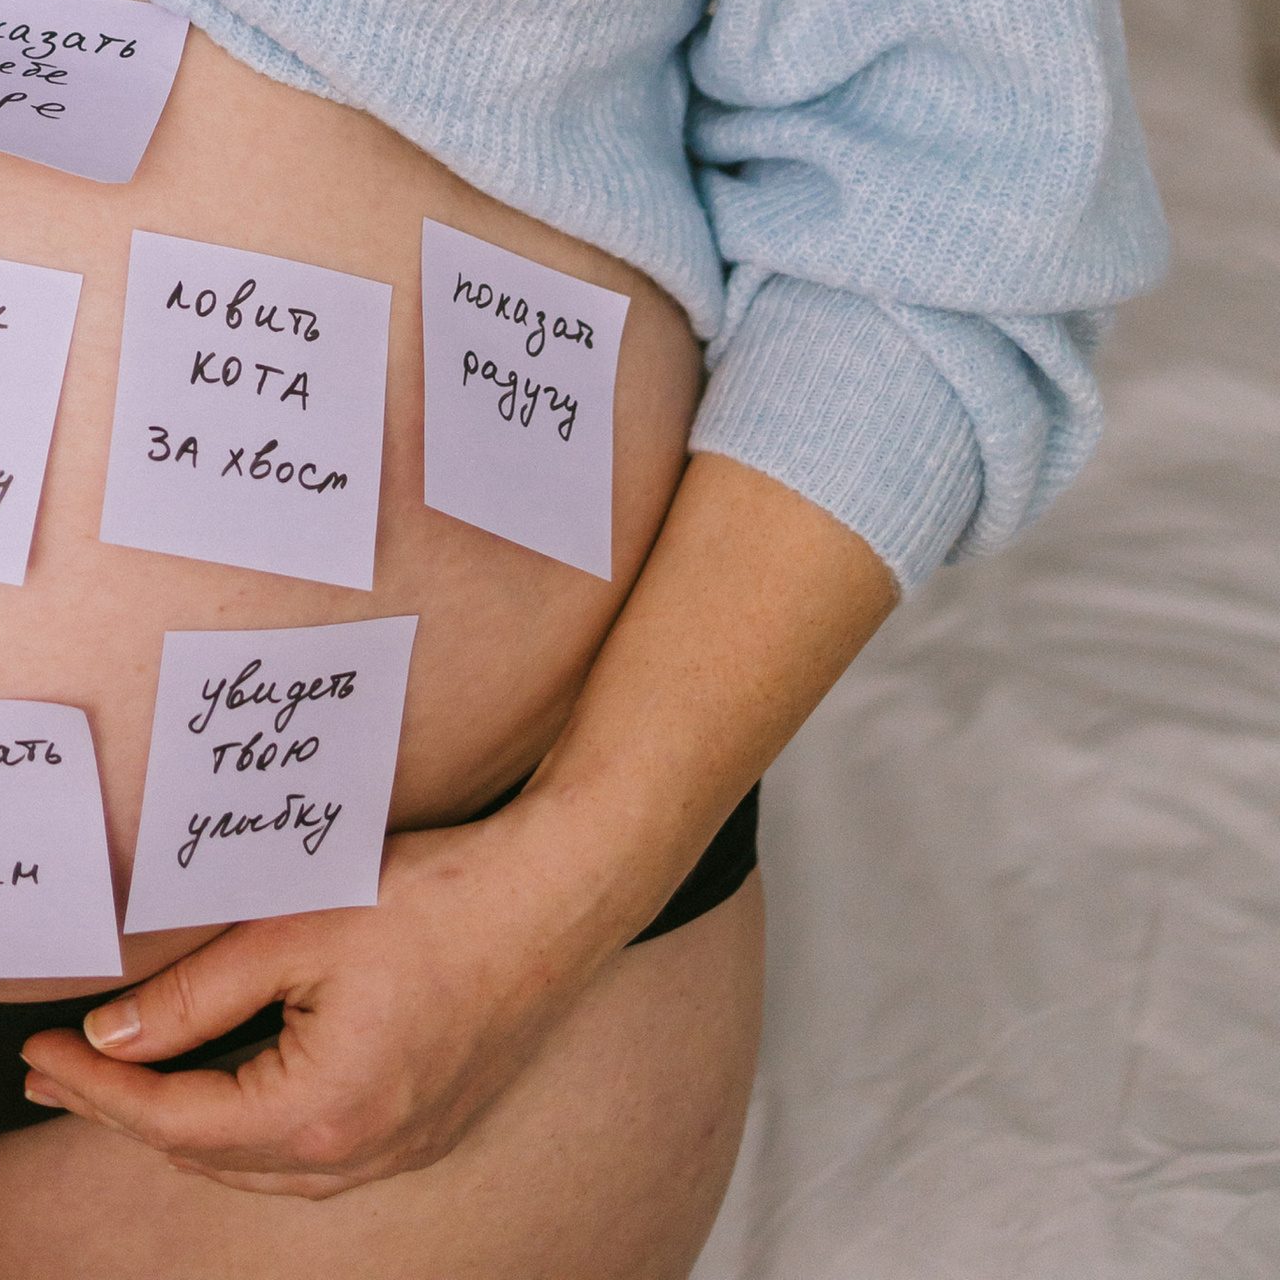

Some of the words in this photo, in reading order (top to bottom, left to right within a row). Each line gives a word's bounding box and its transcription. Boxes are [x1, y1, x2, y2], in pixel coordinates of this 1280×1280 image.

[165, 278, 321, 343] ловить
[452, 269, 597, 359] показать
[462, 347, 579, 443] радугу
[220, 438, 348, 495] хвост
[187, 658, 358, 736] увидеть
[212, 728, 320, 775] твою
[177, 793, 343, 870] улыбку
